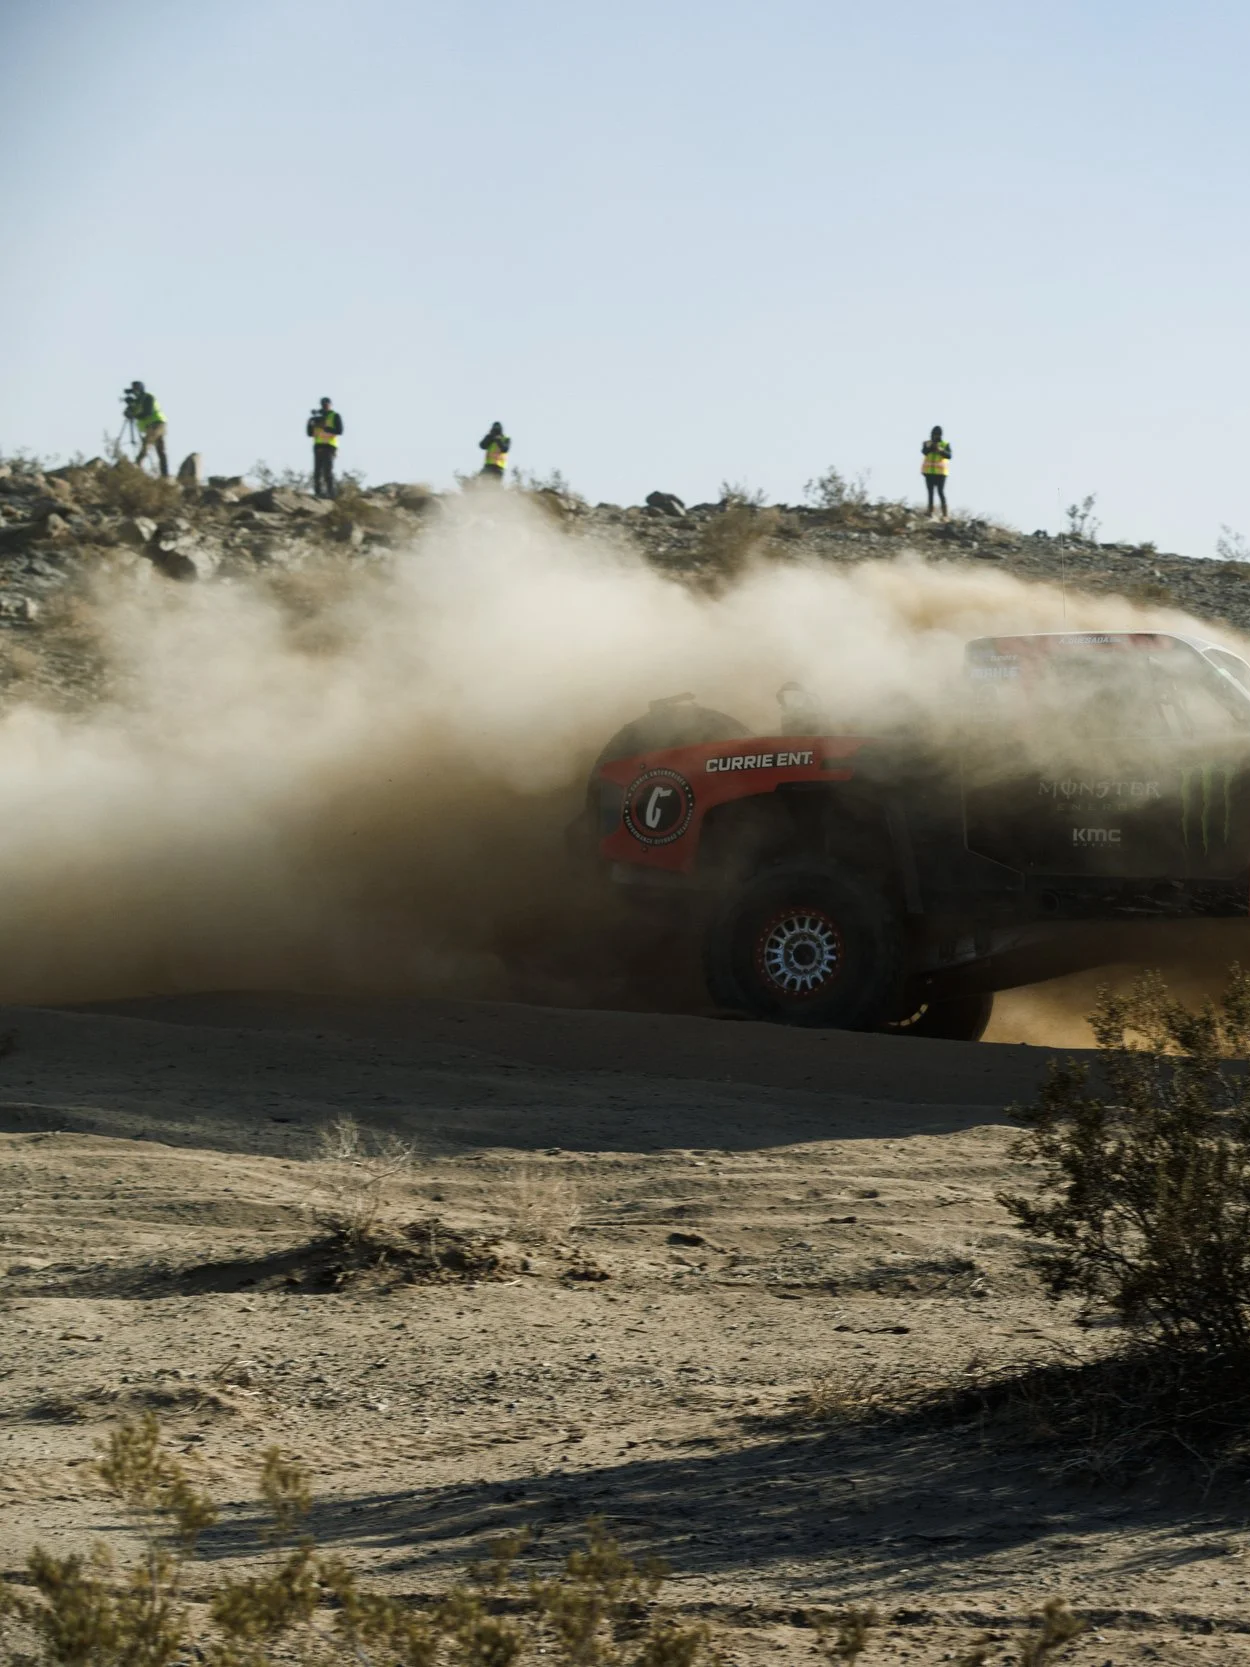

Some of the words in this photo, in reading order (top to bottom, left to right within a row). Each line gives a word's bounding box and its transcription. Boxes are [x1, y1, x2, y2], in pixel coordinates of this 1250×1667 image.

[705, 754, 774, 773] CURRIE
[776, 751, 813, 766] ENT.
[1038, 778, 1161, 799] MONSTER
